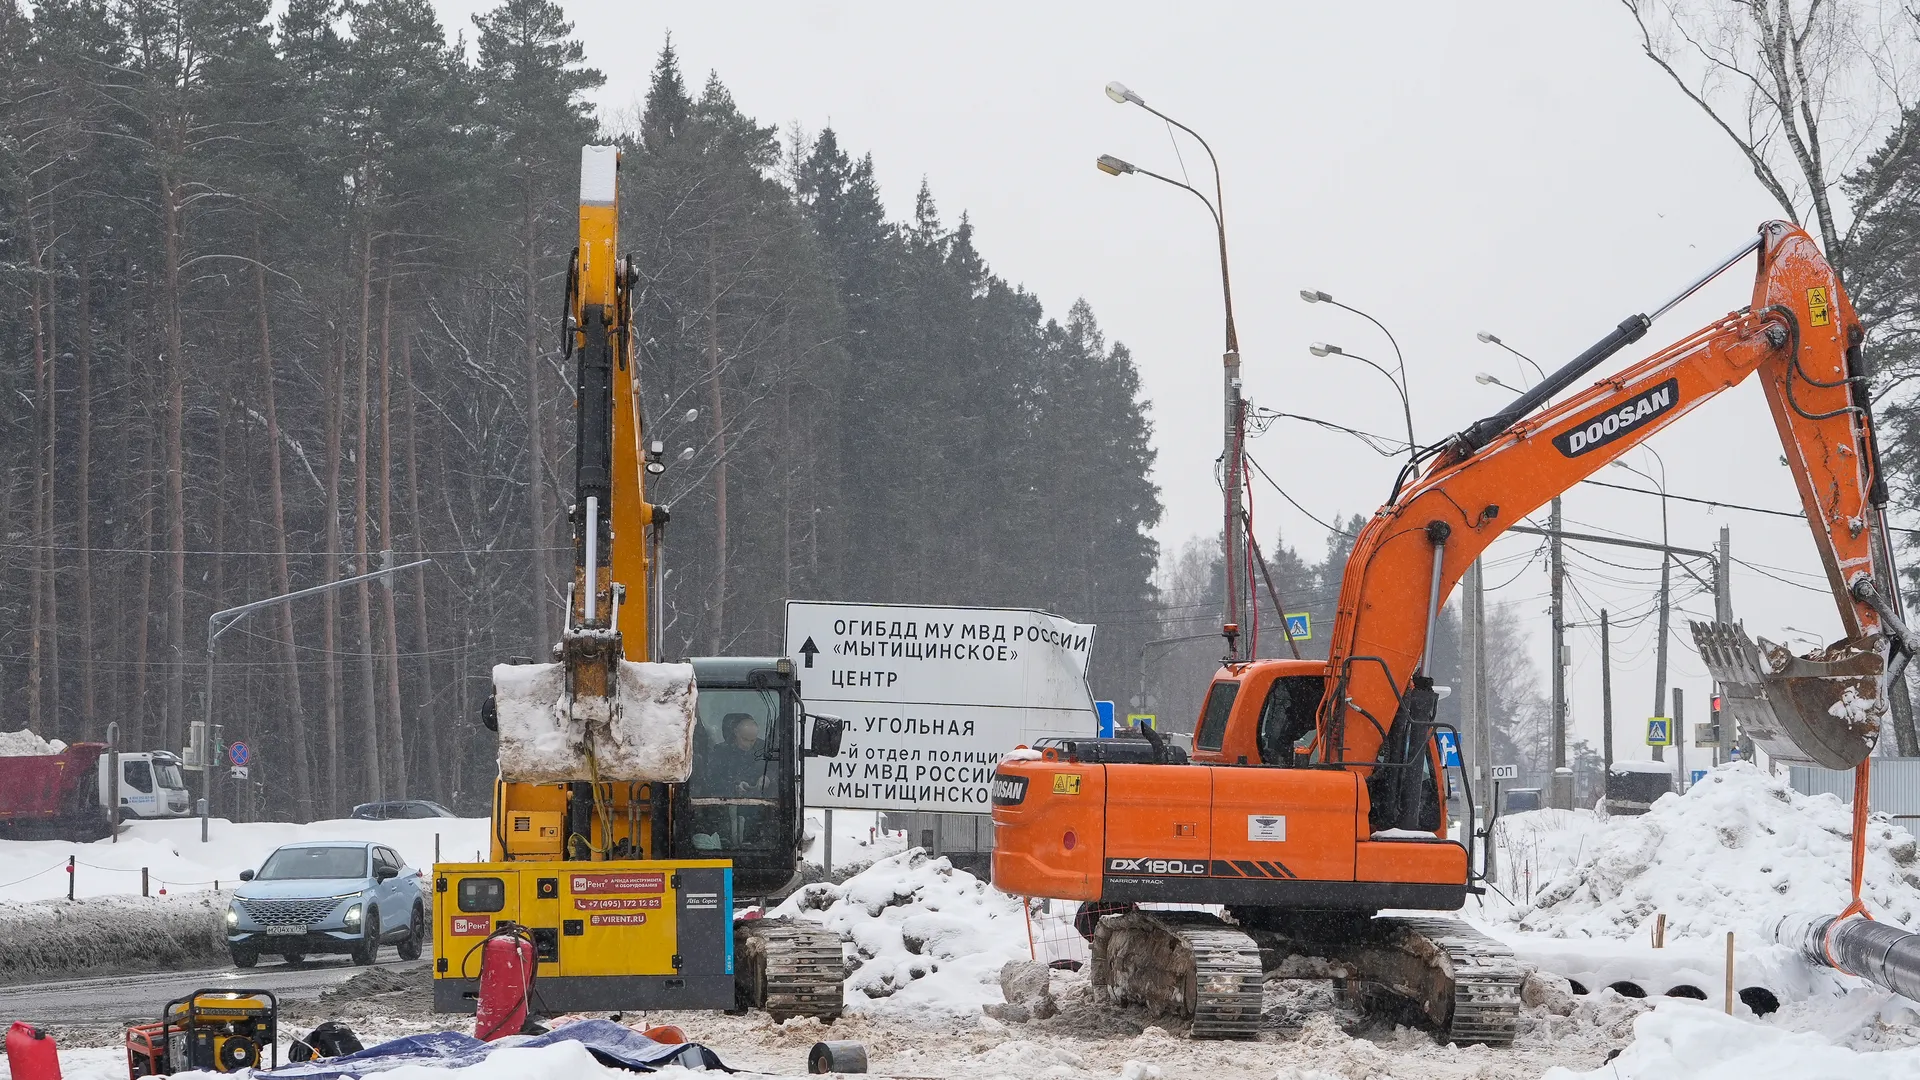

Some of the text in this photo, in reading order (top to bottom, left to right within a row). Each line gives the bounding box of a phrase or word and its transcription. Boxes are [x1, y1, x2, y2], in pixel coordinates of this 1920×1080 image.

[1569, 387, 1670, 454] DOOSAN
[834, 619, 1088, 652] ОГИБДД МУ МВД РОССИИ
[833, 640, 1018, 661] «МЫТИЩИНСКОЕ»
[832, 670, 898, 689] ЦЕНТР
[841, 716, 974, 736] л. УГОЛЬНАЯ
[840, 743, 1004, 766] -й отдел полици
[828, 762, 857, 778] МУ
[864, 763, 908, 783] МВД
[1491, 766, 1513, 778] ТОП
[827, 782, 988, 804] «МЫТИЩИНСКО
[993, 780, 1024, 800] OOSAN
[600, 900, 621, 908] (495)
[602, 915, 644, 923] VIRENT.RU
